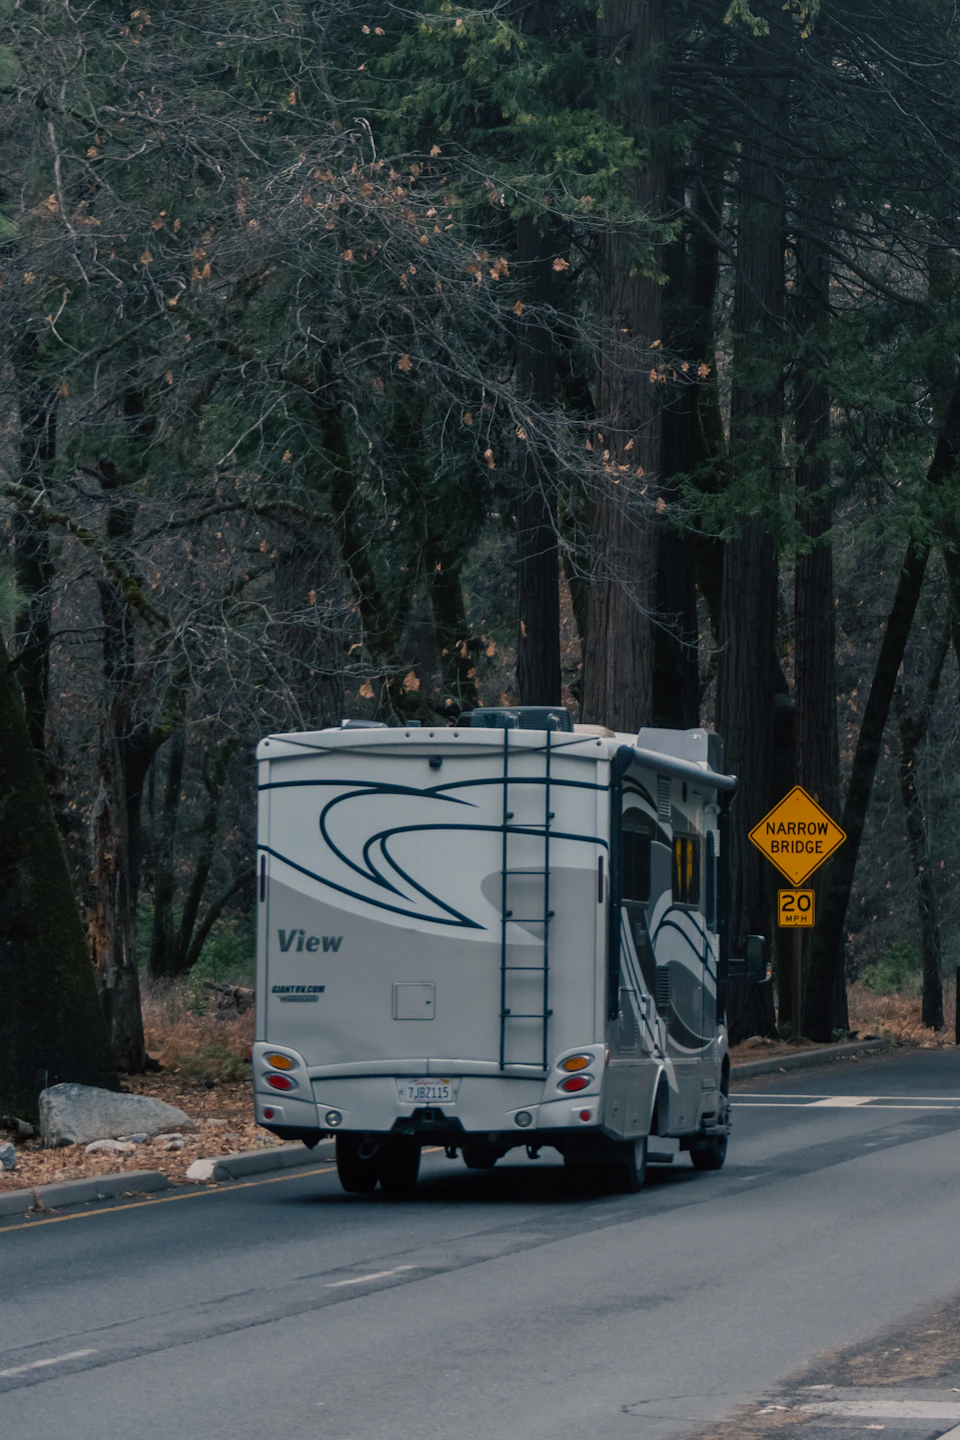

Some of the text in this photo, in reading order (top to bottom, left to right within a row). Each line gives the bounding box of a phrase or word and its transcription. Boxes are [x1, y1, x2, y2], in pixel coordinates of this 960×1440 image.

[766, 822, 829, 835] NARROW
[771, 840, 824, 853] BRIDGE
[781, 894, 811, 912] 20
[276, 928, 344, 953] View
[408, 1086, 449, 1099] 7JBZ115
